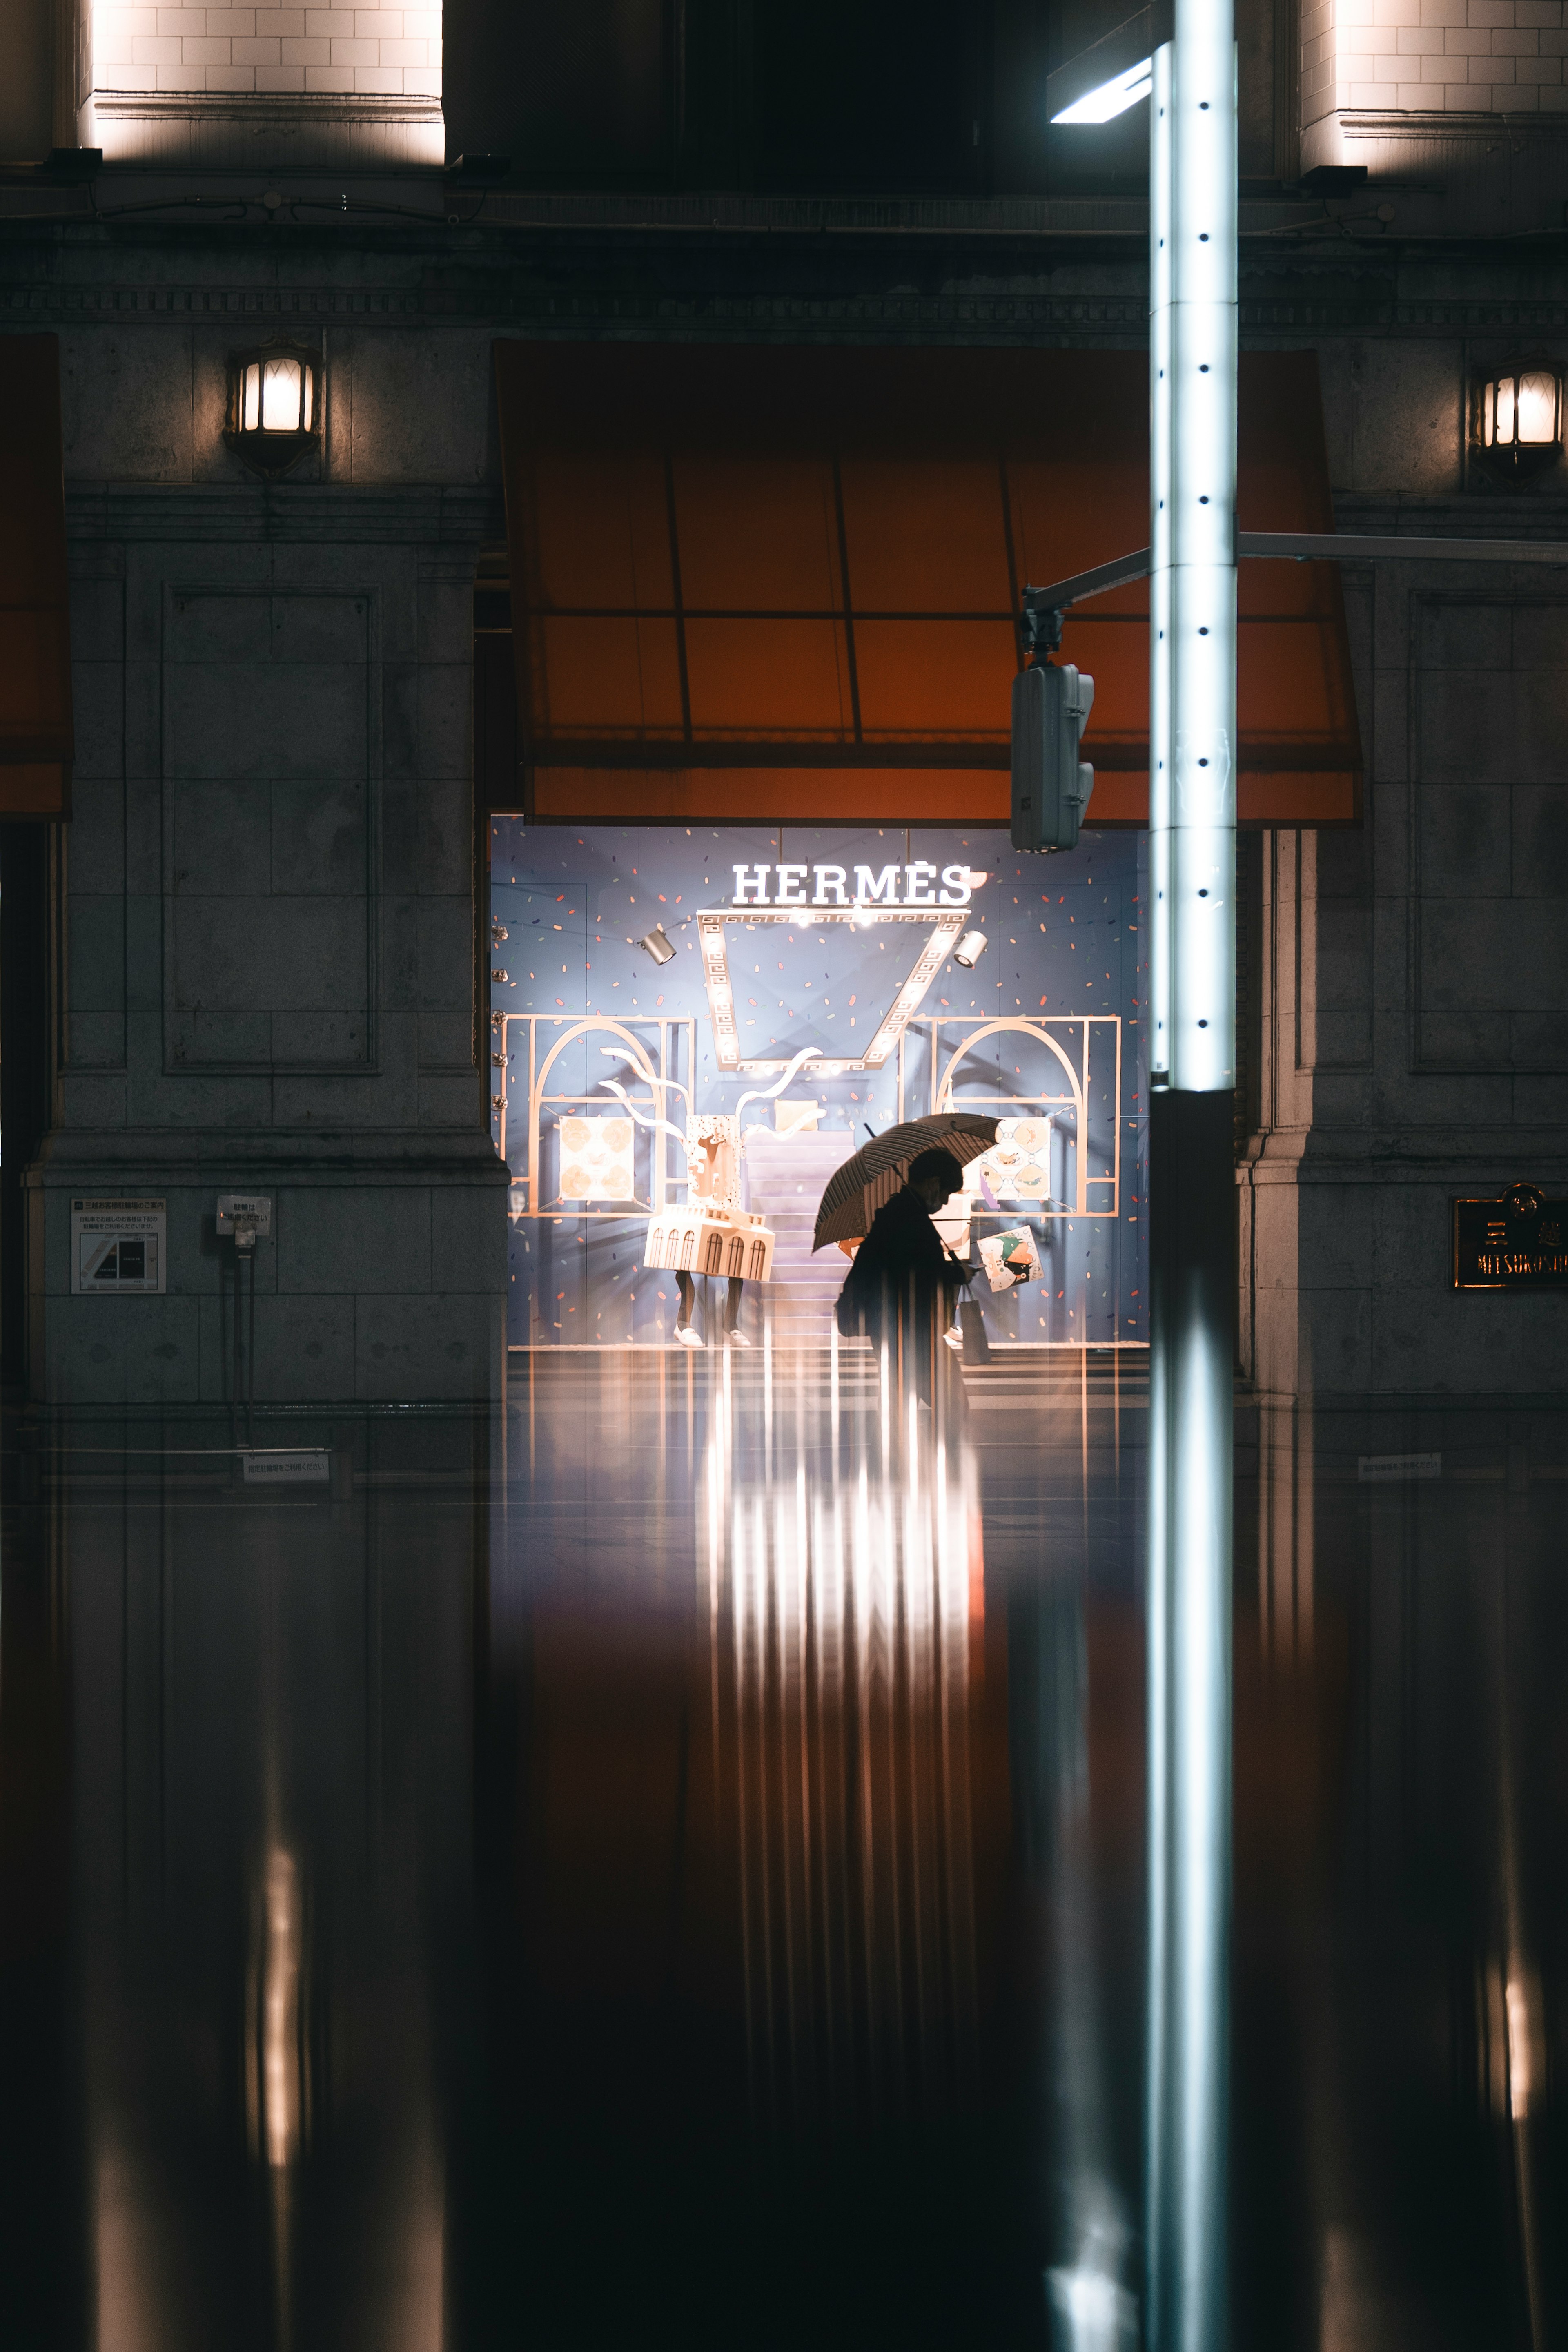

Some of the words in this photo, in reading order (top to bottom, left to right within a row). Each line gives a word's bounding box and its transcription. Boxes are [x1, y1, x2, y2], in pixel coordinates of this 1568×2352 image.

[732, 861, 971, 905] HERMÈS
[222, 1213, 267, 1221] ご遠慮ください
[248, 1463, 325, 1473] 指定駐輪場をご利用ください
